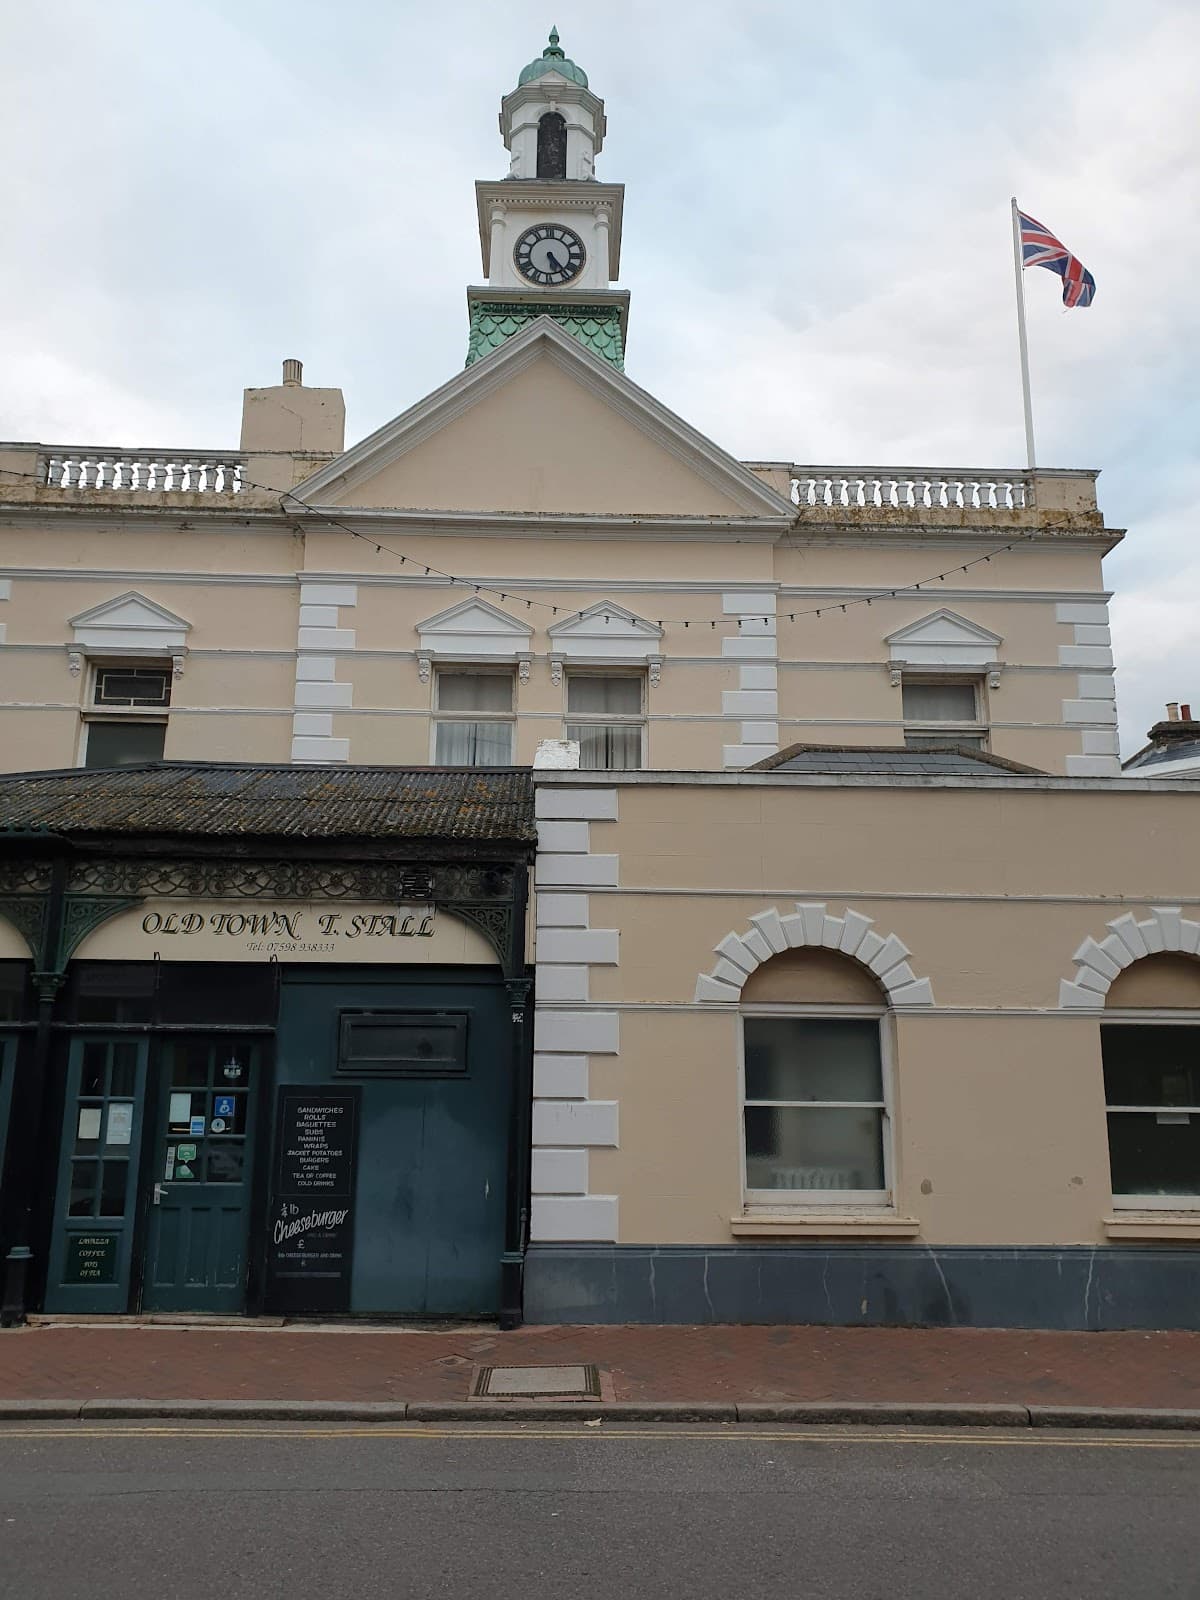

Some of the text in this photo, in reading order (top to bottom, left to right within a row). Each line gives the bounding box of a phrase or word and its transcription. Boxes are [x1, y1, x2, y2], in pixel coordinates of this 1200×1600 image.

[142, 911, 437, 941] OLD TOWN T. STALL
[246, 941, 335, 953] Tel: 07598 938333
[304, 1128, 324, 1136] SUBS
[273, 1209, 349, 1245] Cheeseburger
[296, 1239, 305, 1249] £
